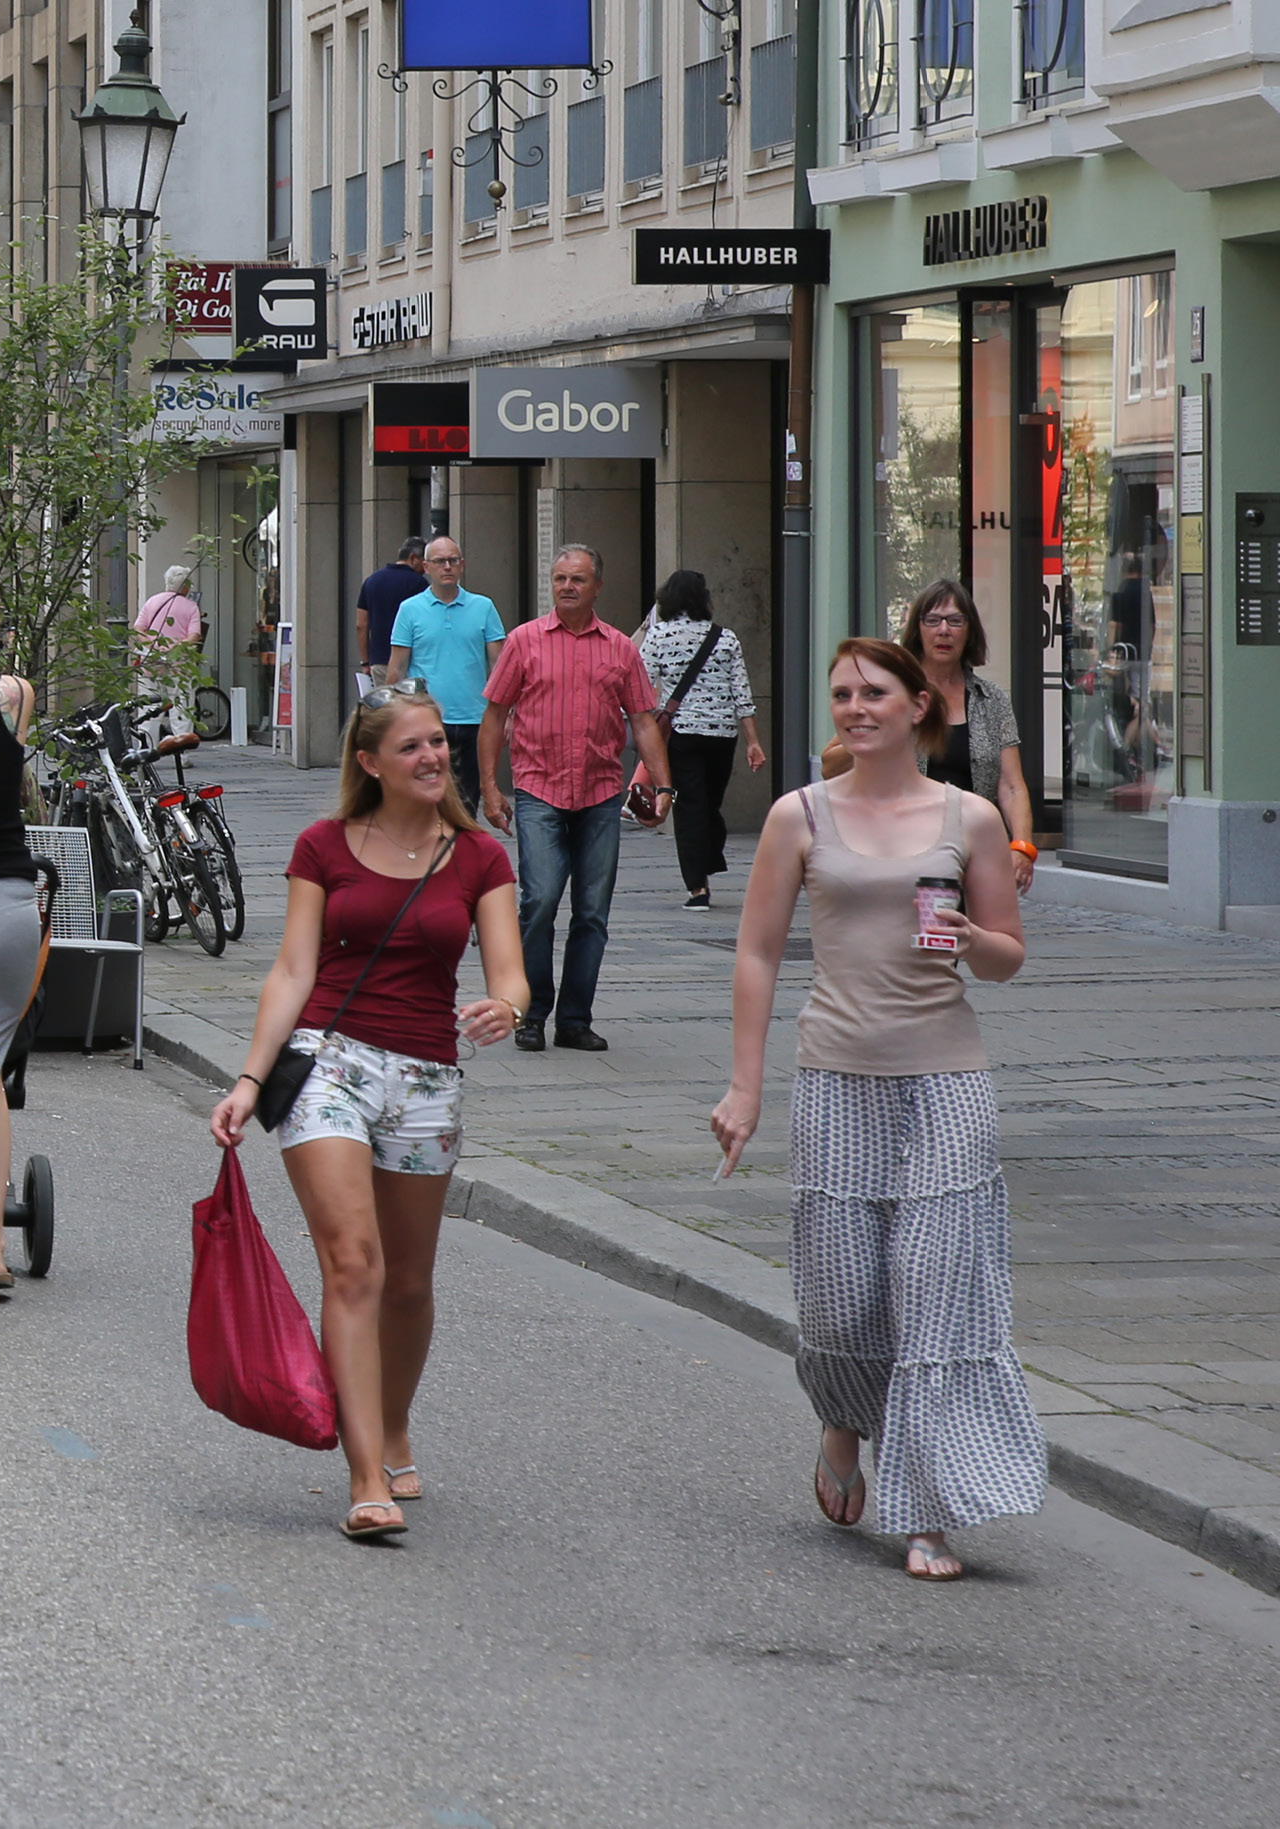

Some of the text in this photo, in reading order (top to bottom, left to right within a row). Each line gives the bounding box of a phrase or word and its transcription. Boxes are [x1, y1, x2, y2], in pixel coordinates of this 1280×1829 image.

[923, 195, 1048, 266] HALLHUBER
[660, 247, 798, 265] HALLHUBER
[177, 271, 207, 291] Tai
[202, 298, 232, 318] Go
[400, 291, 433, 340] RAW
[262, 334, 316, 349] RAW
[155, 384, 261, 411] ReSale
[497, 389, 640, 432] Gabor
[155, 415, 198, 431] second
[202, 415, 231, 431] hand
[249, 420, 280, 431] more
[409, 428, 469, 449] LLO
